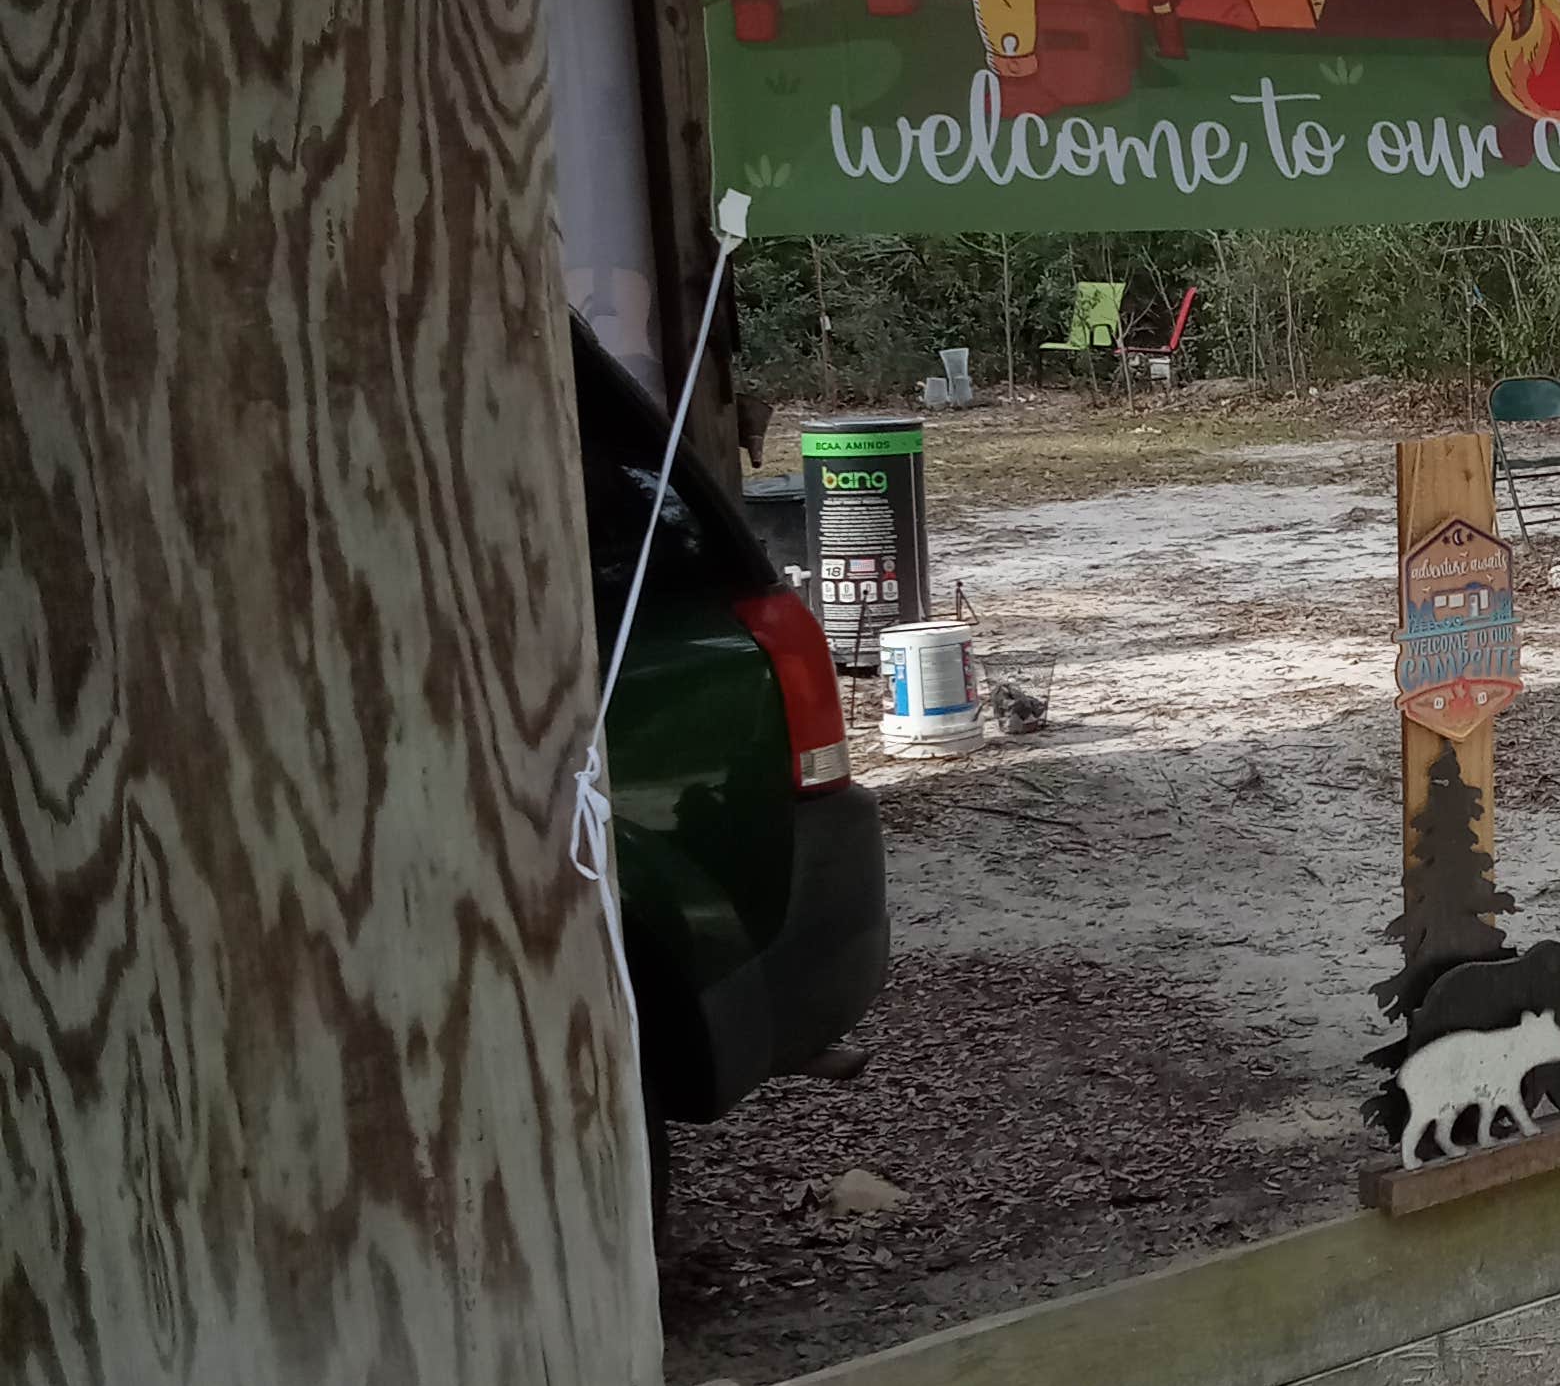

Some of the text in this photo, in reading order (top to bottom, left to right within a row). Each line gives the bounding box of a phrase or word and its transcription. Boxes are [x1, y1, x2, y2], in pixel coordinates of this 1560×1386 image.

[829, 68, 1248, 188] welcome
[1231, 76, 1346, 180] to
[1366, 120, 1503, 189] our
[845, 441, 890, 450] AMINOS
[822, 466, 888, 493] bang
[826, 567, 841, 577] 18
[1411, 549, 1507, 579] adventure awaits
[1408, 625, 1513, 656] WELCOME TO OUR
[1401, 646, 1519, 691] CAMPSITE
